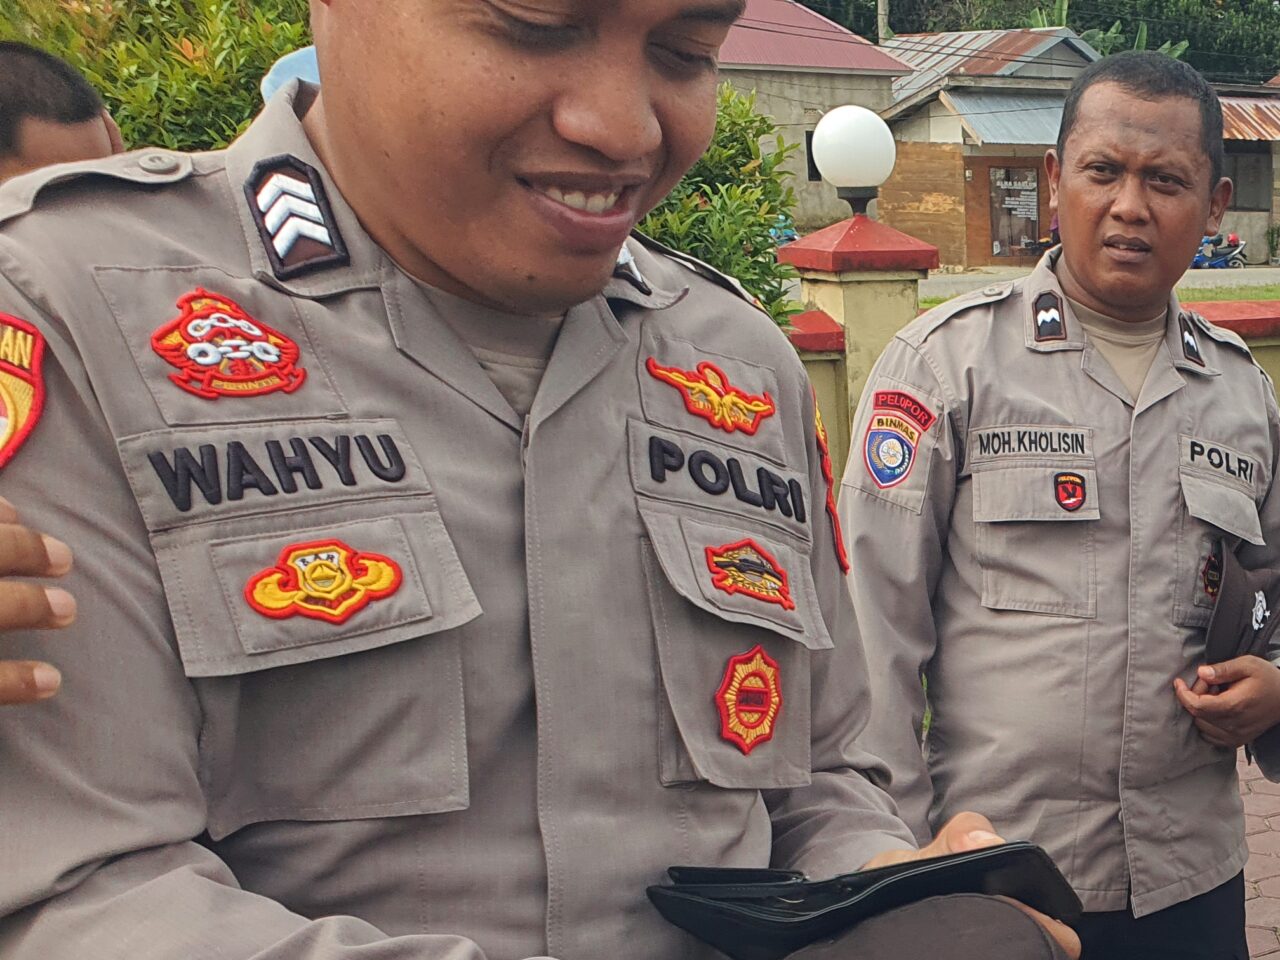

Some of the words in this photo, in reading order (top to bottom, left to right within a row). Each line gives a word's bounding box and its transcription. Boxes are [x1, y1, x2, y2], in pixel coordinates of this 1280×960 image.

[876, 418, 916, 441] BINMAS
[878, 394, 930, 425] PELOPOR
[148, 433, 408, 512] WAHYU
[648, 436, 807, 524] POLRI
[1189, 440, 1255, 484] POLRI
